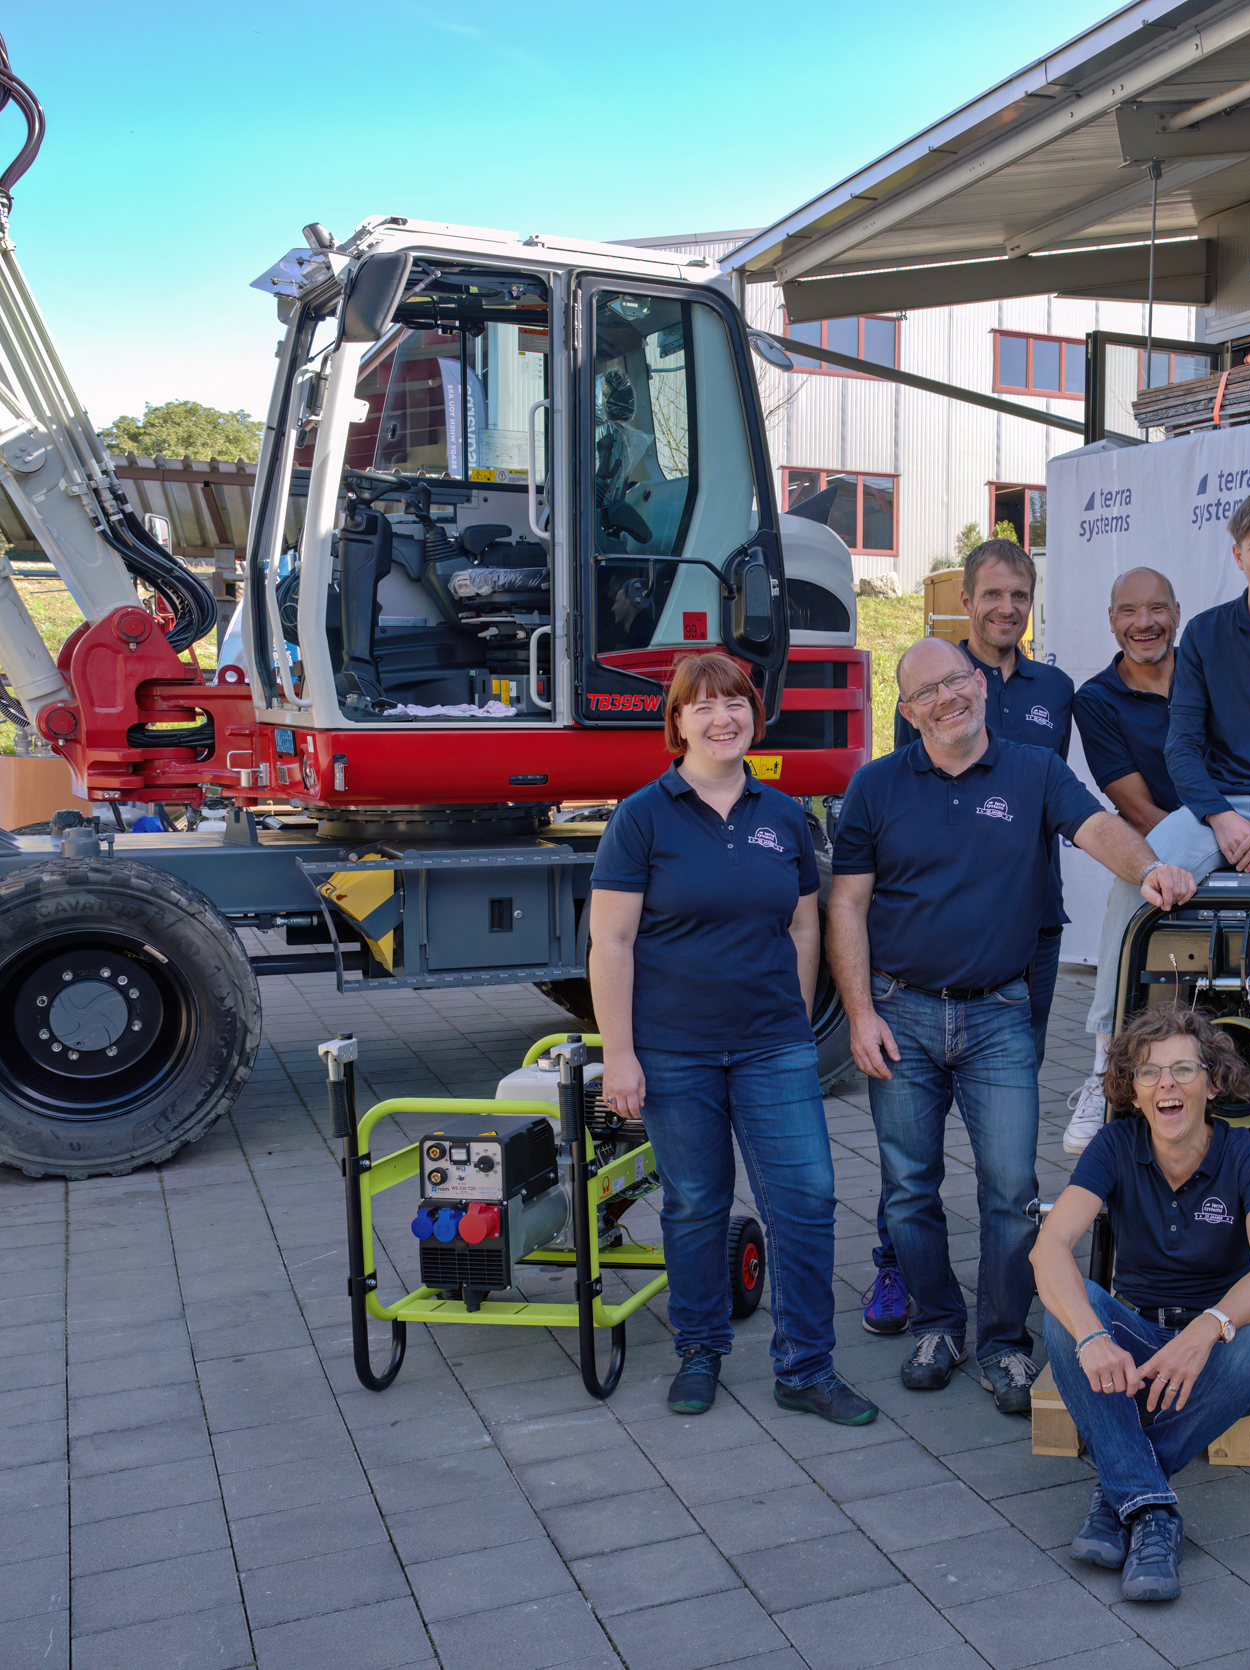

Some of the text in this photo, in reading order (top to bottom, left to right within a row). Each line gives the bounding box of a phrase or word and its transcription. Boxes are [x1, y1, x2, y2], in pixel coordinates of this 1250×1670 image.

[1098, 485, 1132, 509] terra
[1191, 497, 1243, 531] system
[1079, 513, 1131, 542] systems
[685, 624, 698, 638] 99
[586, 693, 662, 711] TB395W
